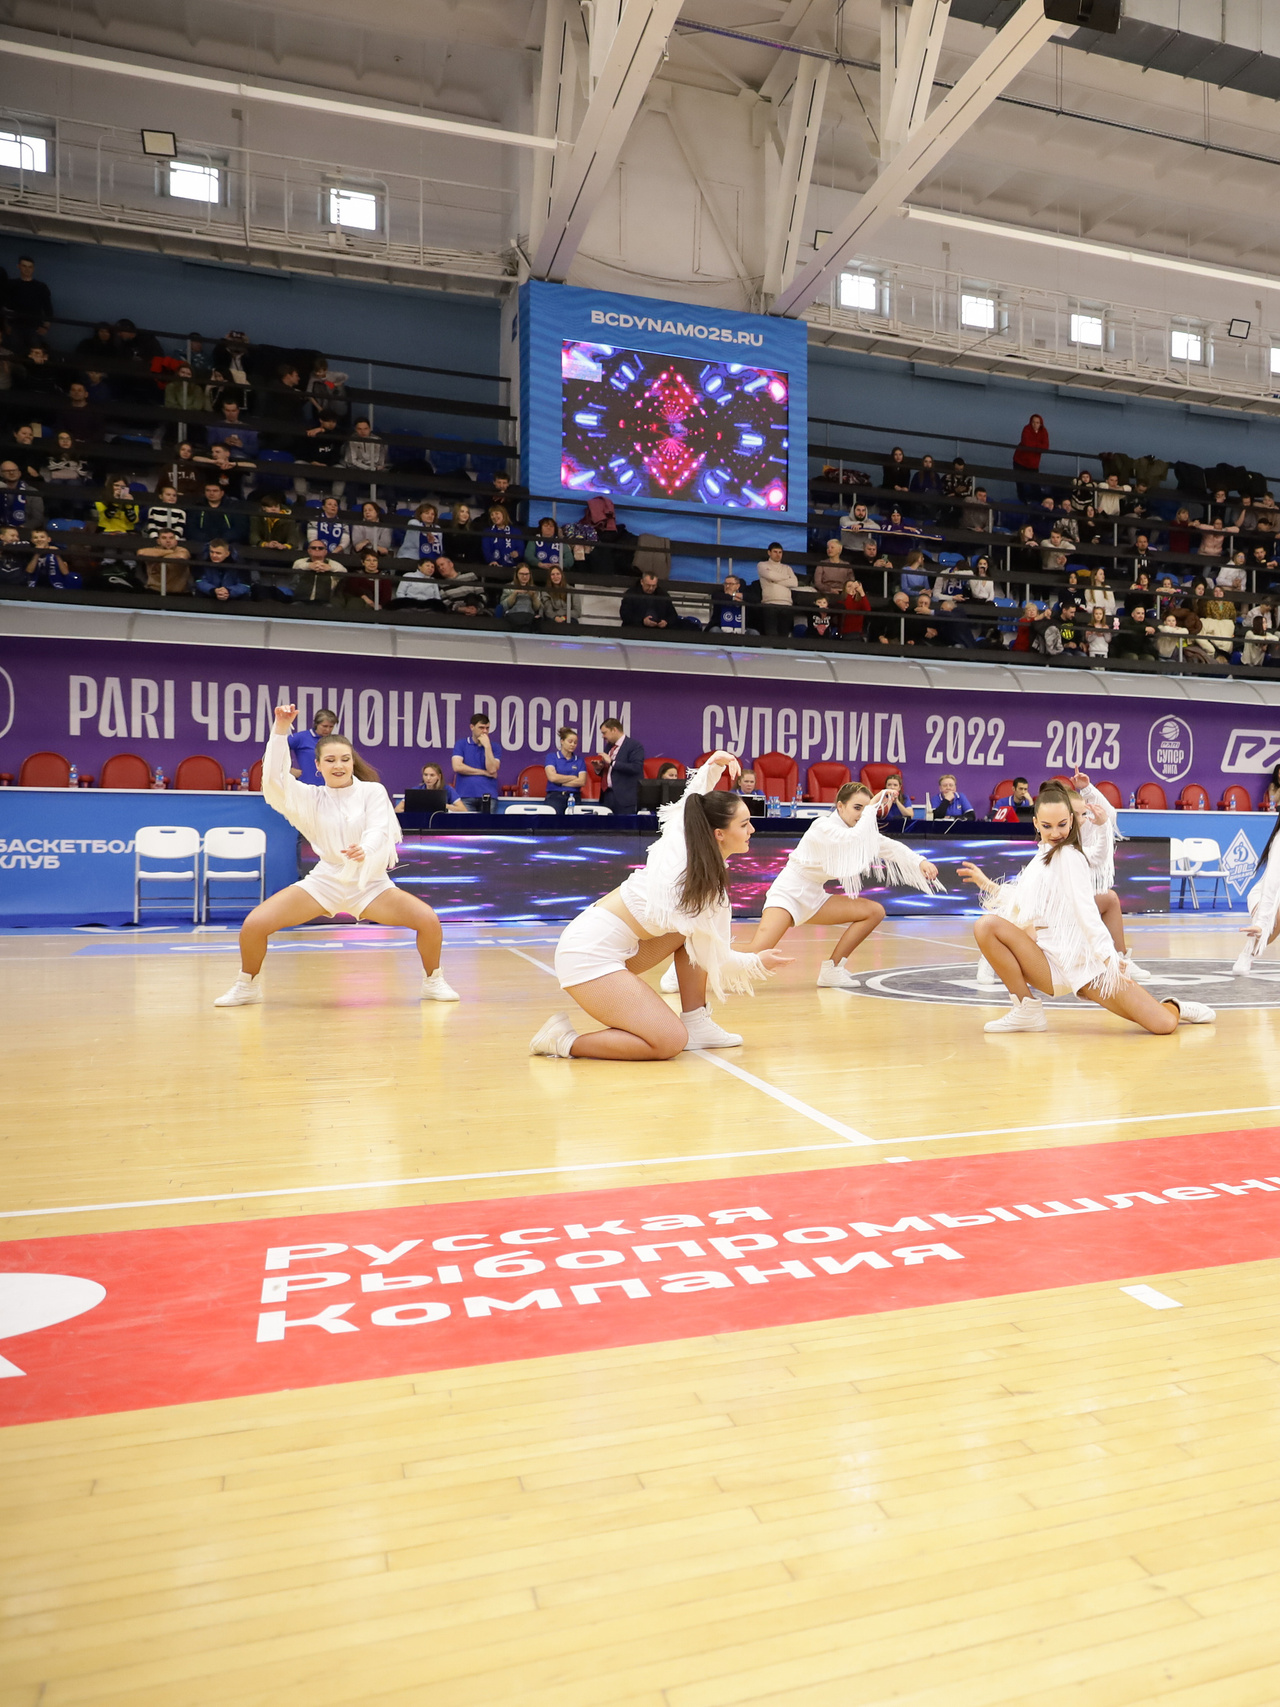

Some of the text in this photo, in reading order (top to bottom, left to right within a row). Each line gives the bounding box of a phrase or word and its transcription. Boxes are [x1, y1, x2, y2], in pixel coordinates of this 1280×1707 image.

[591, 310, 763, 347] BCDYNAMO25.RU
[69, 675, 174, 739] PARI
[191, 681, 461, 749] ЧЕМПИОНАТ
[702, 704, 906, 763] СУПЕРЛИГА
[264, 1206, 773, 1270] Русская
[256, 1242, 965, 1342] Компания
